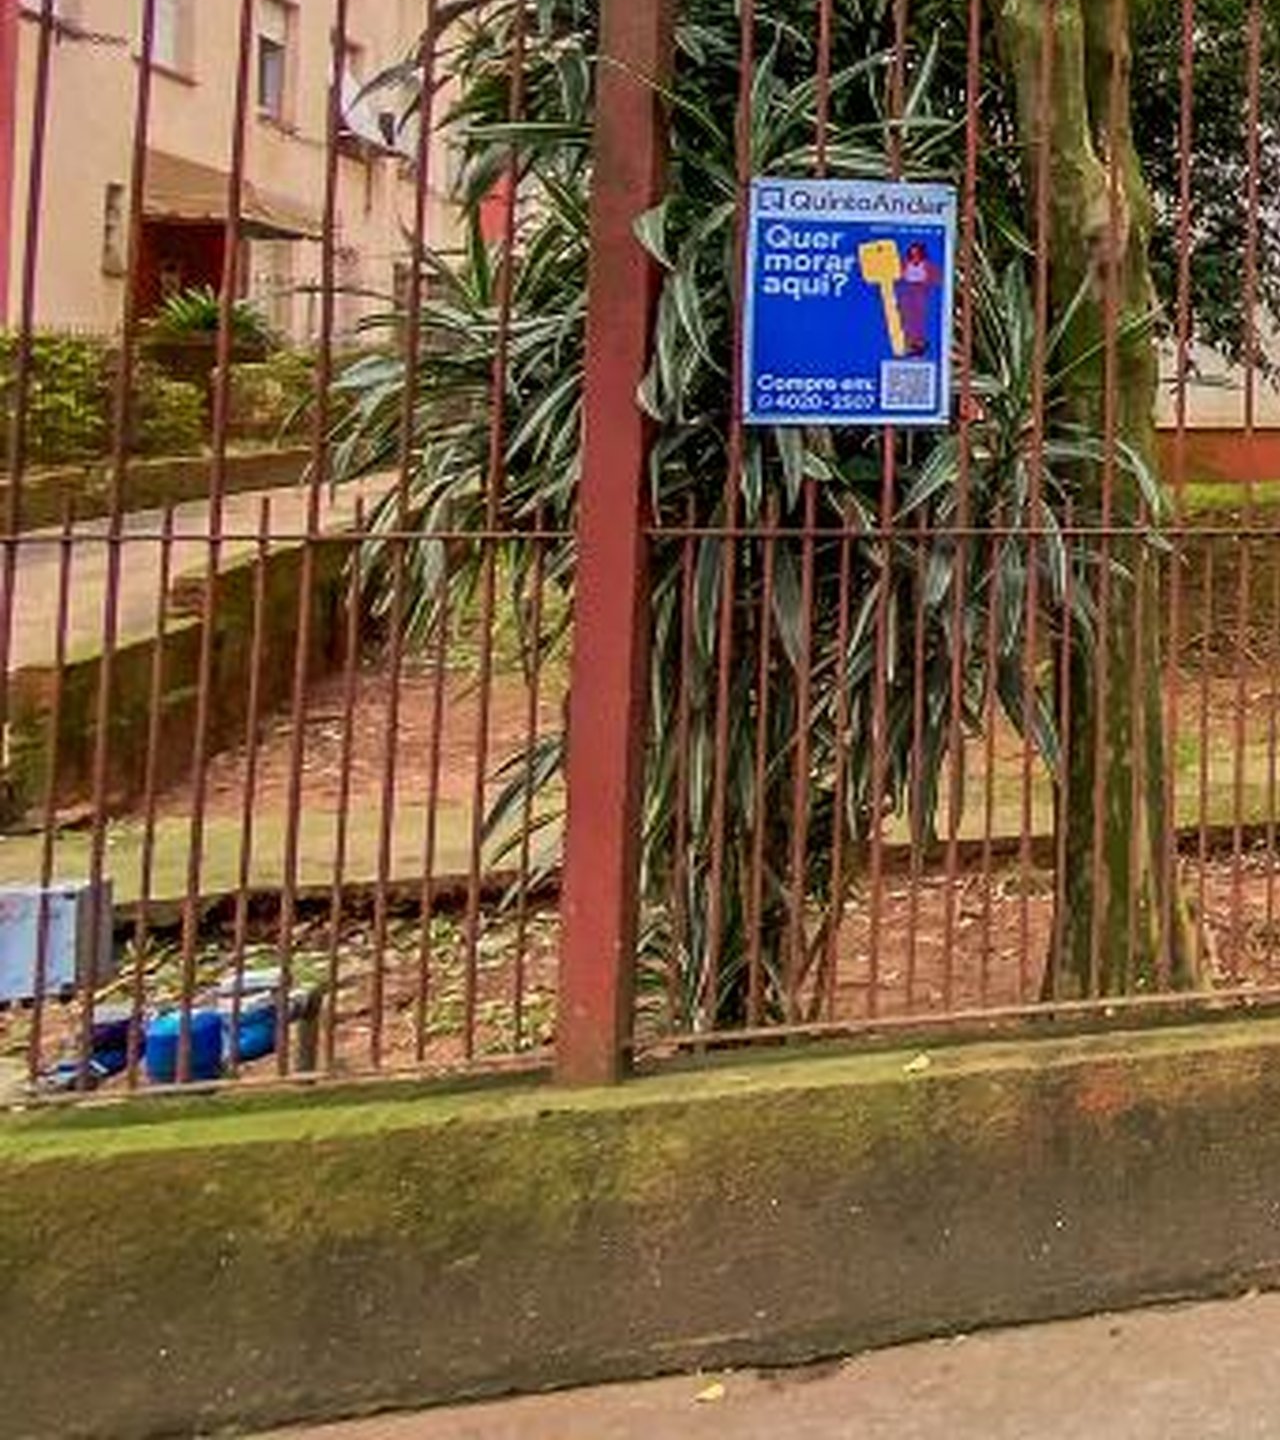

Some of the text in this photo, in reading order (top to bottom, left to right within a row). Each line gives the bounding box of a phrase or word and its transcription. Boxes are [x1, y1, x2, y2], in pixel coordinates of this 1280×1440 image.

[789, 189, 949, 215] QuintoAndar
[765, 224, 843, 249] Quer
[763, 252, 856, 273] morar
[763, 274, 849, 301] aqui?
